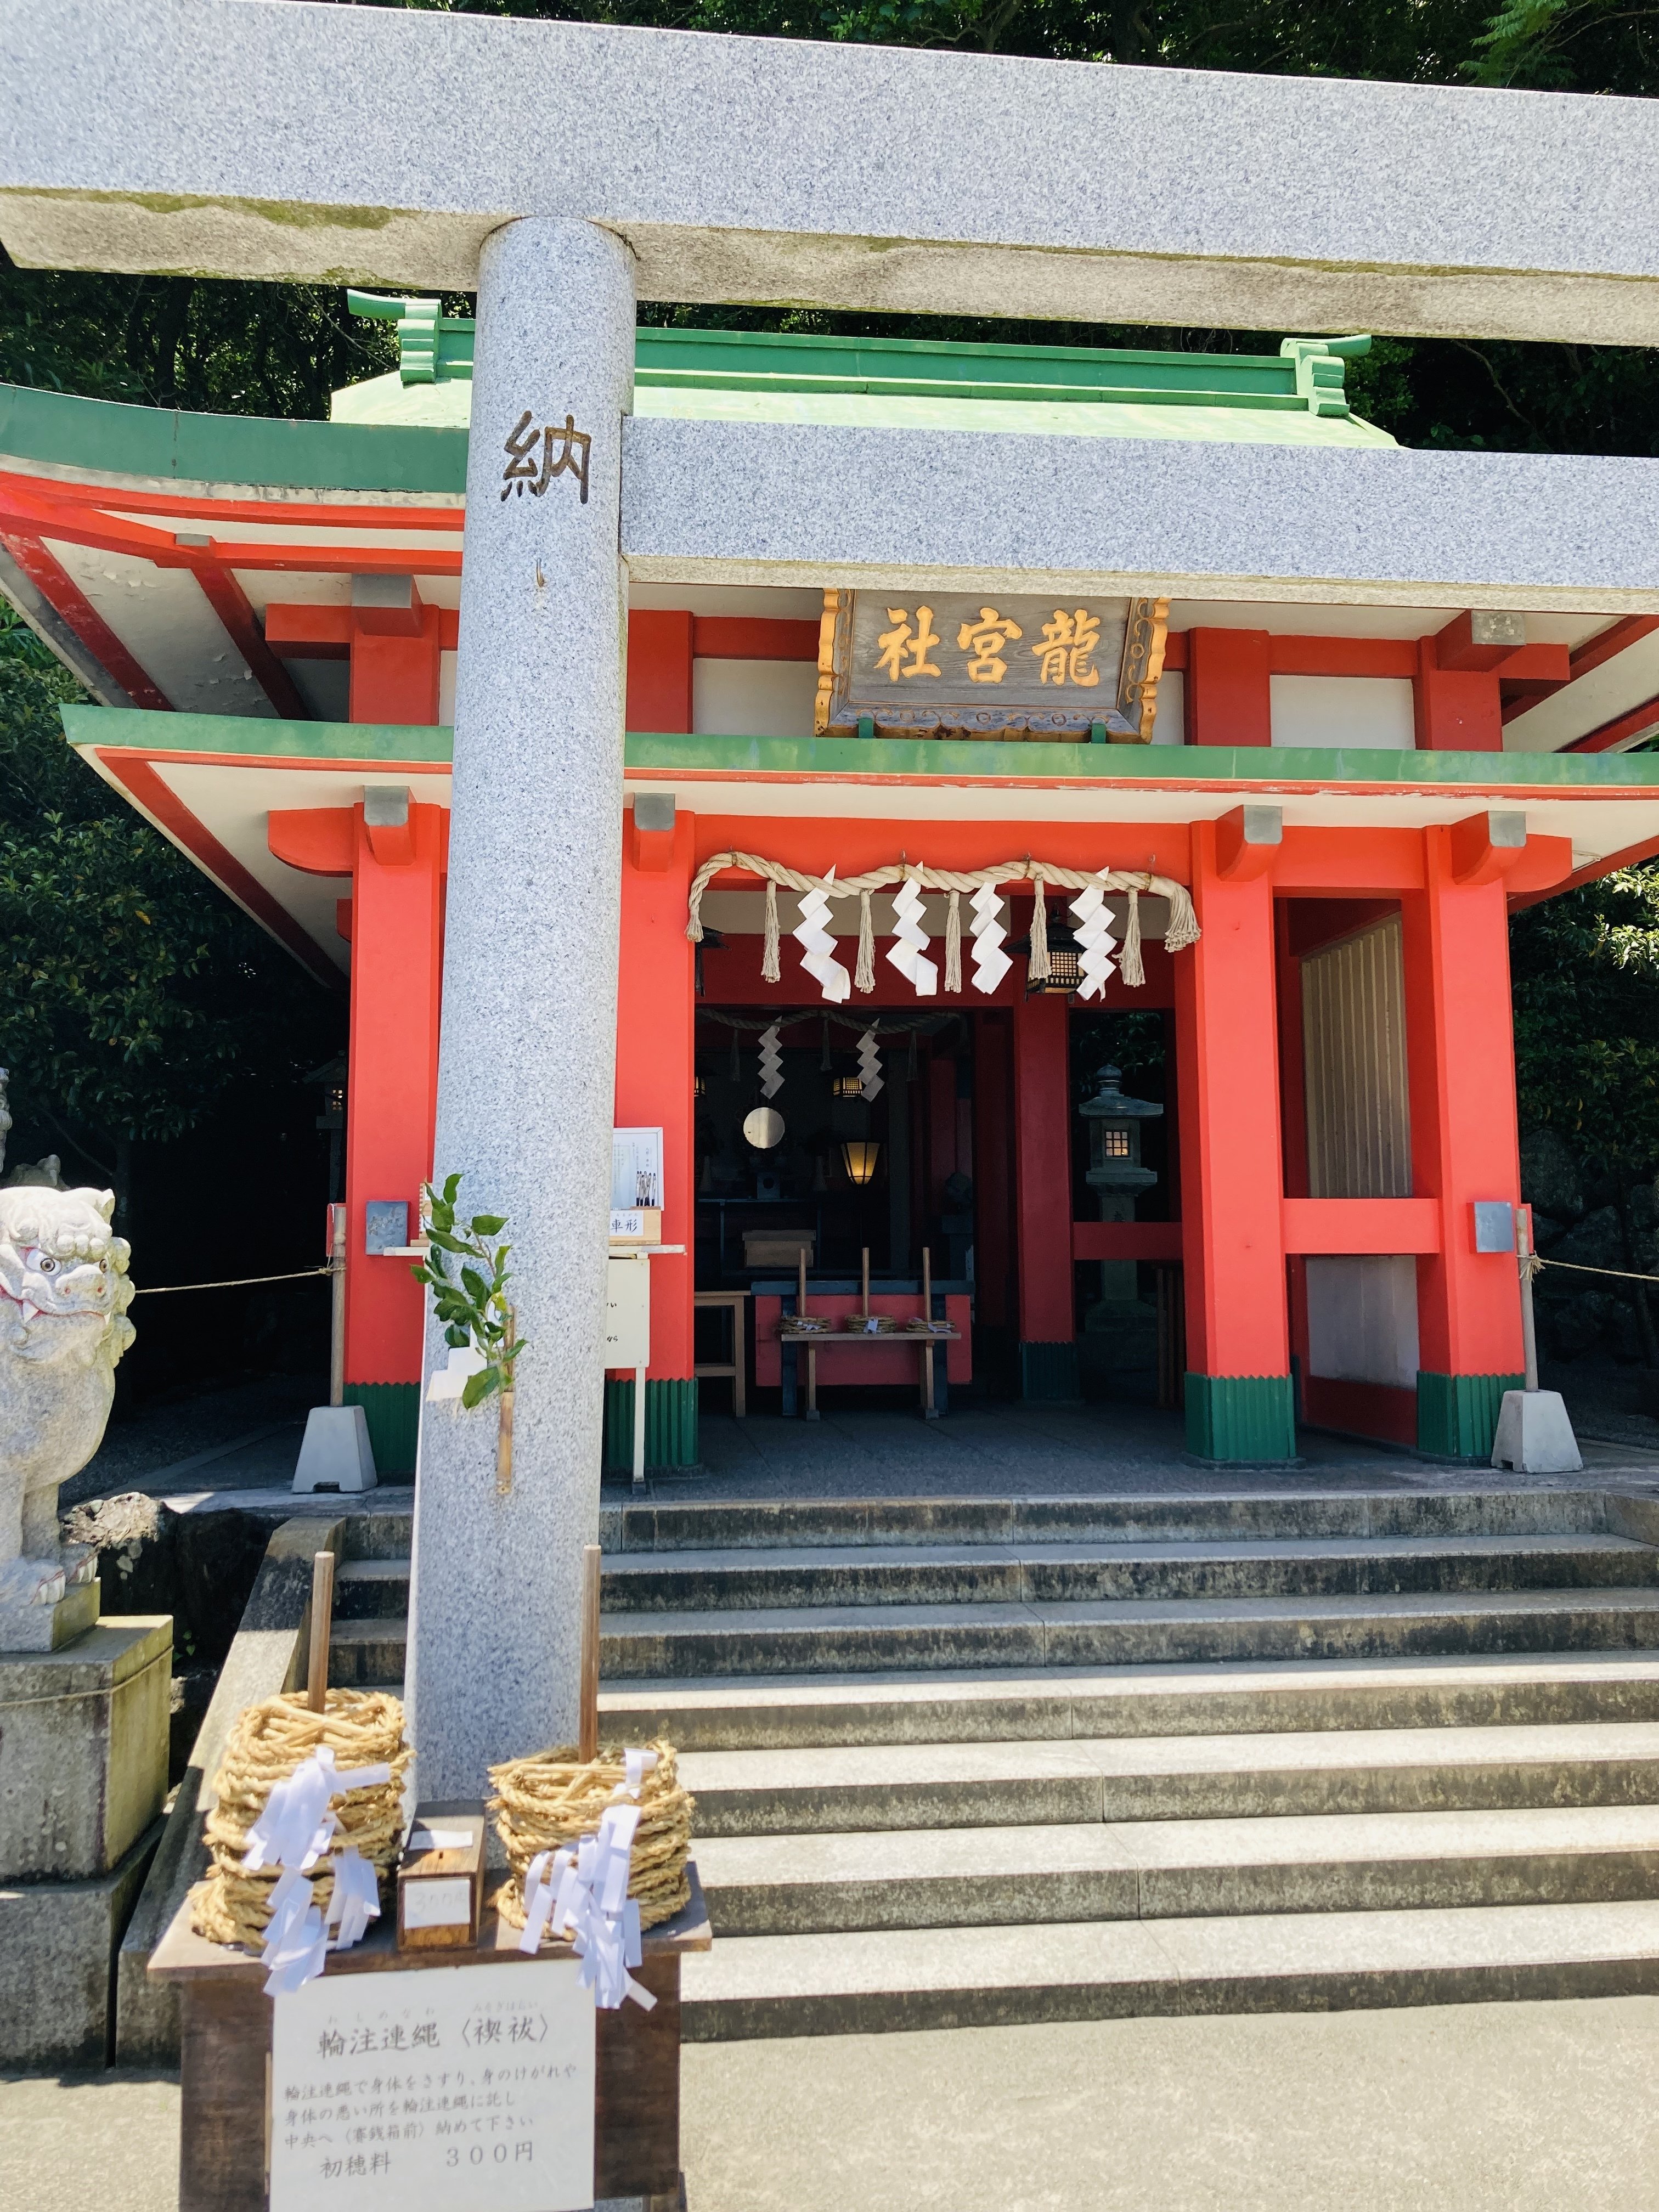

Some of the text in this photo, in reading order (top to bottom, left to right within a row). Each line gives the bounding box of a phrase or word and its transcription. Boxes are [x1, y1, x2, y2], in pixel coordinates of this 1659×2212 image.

[500, 410, 592, 505] 納
[873, 605, 1101, 687] 龍宮社
[319, 2149, 392, 2180] 初穂料
